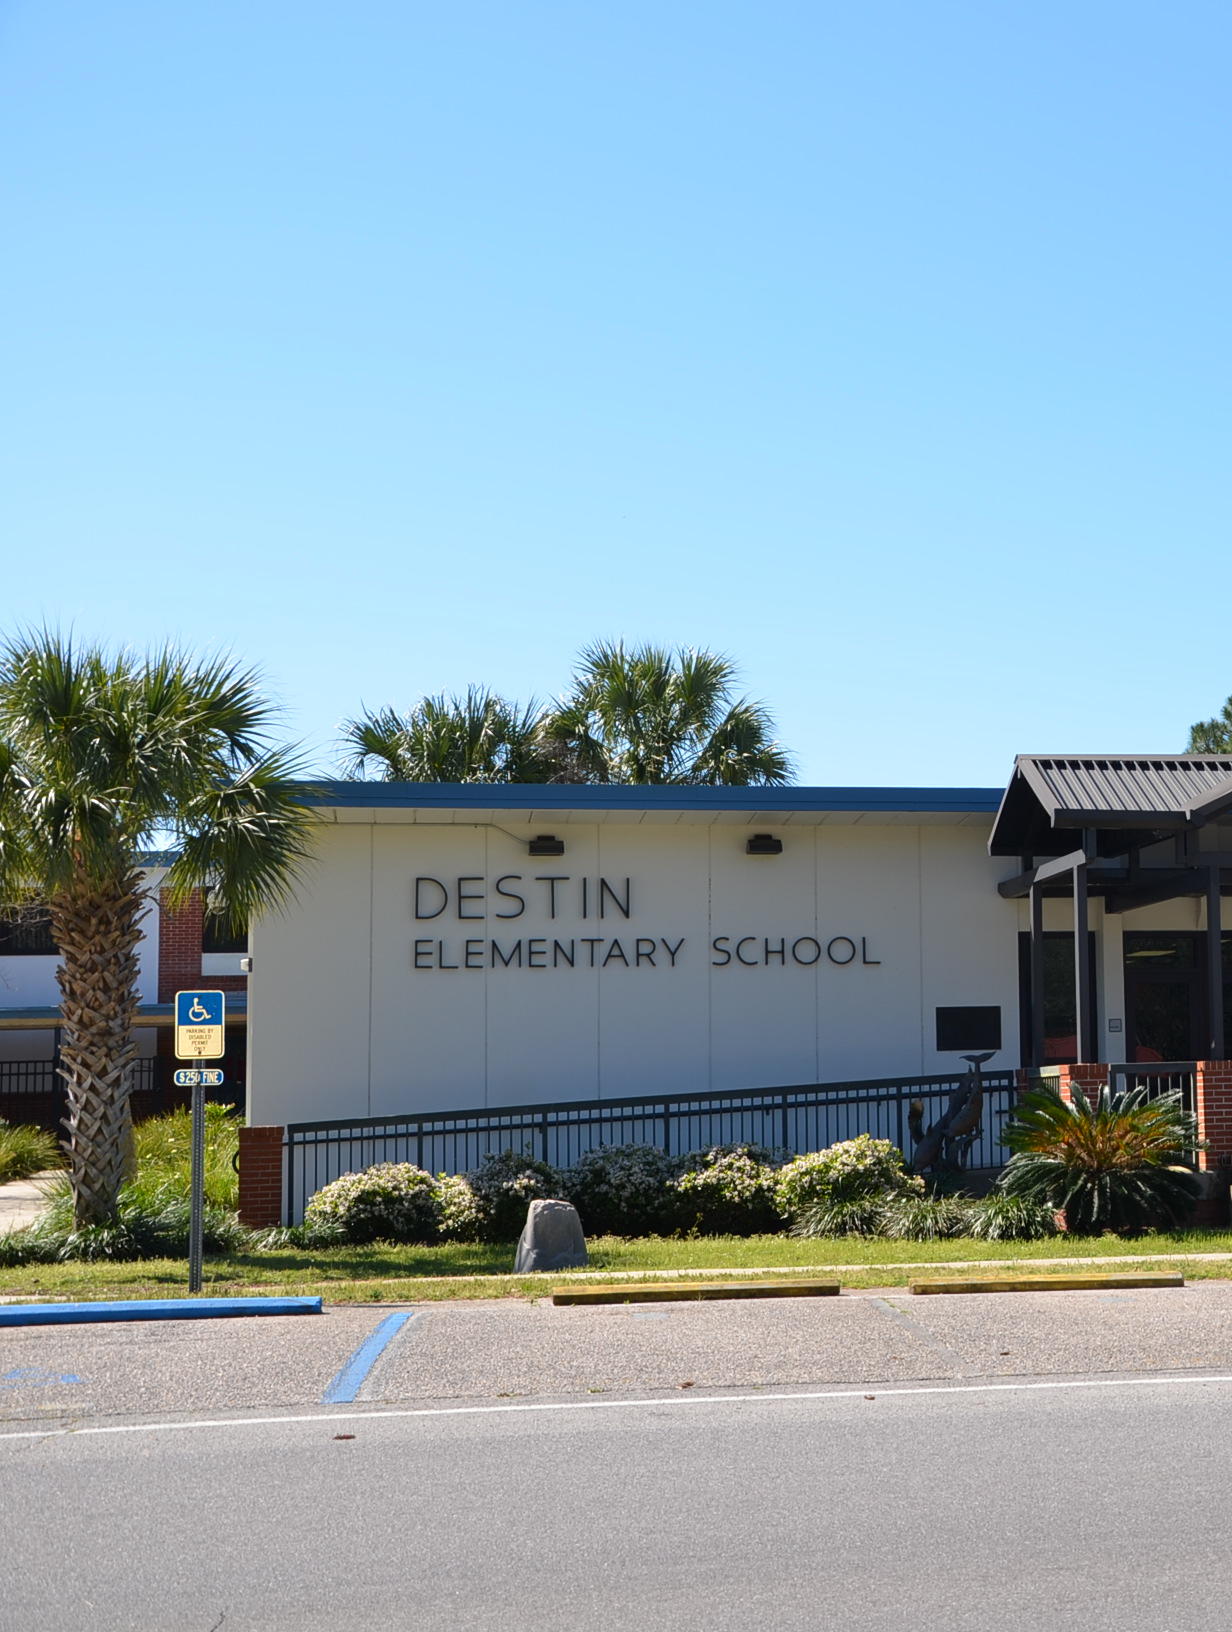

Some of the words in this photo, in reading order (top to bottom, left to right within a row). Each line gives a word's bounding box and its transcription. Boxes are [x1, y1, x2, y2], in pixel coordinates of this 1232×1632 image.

[414, 875, 631, 920] DESTIN
[414, 937, 686, 969] ELEMENTARY
[711, 936, 882, 967] SCHOOL
[202, 1072, 219, 1083] FINE
